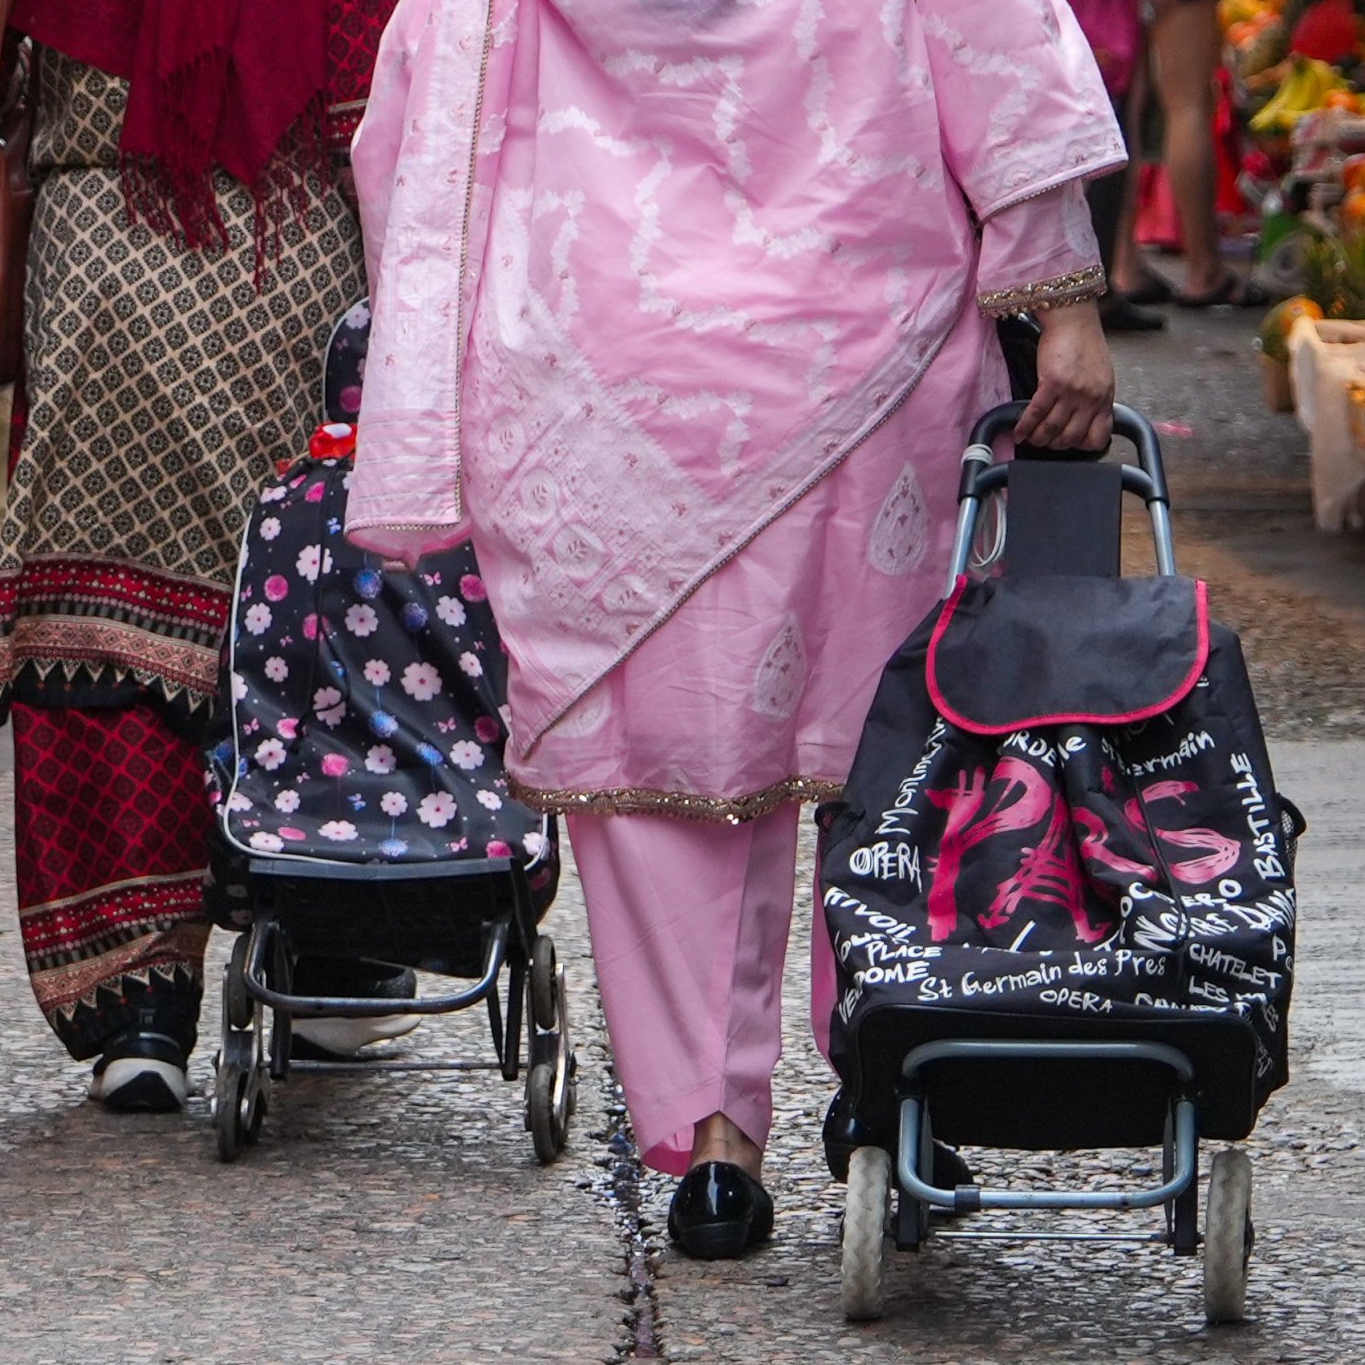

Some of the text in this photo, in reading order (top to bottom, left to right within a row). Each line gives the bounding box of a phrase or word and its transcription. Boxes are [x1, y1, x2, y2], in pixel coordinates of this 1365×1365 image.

[1230, 752, 1285, 881] BASTILLE
[848, 841, 923, 894] OPERA
[925, 755, 1241, 943] PARS
[865, 940, 943, 967] PLACE
[917, 948, 1167, 1002] St Germain des Pres
[1189, 943, 1283, 989] CHATELET
[1039, 987, 1114, 1014] OPERA
[1188, 975, 1230, 1003] LES
